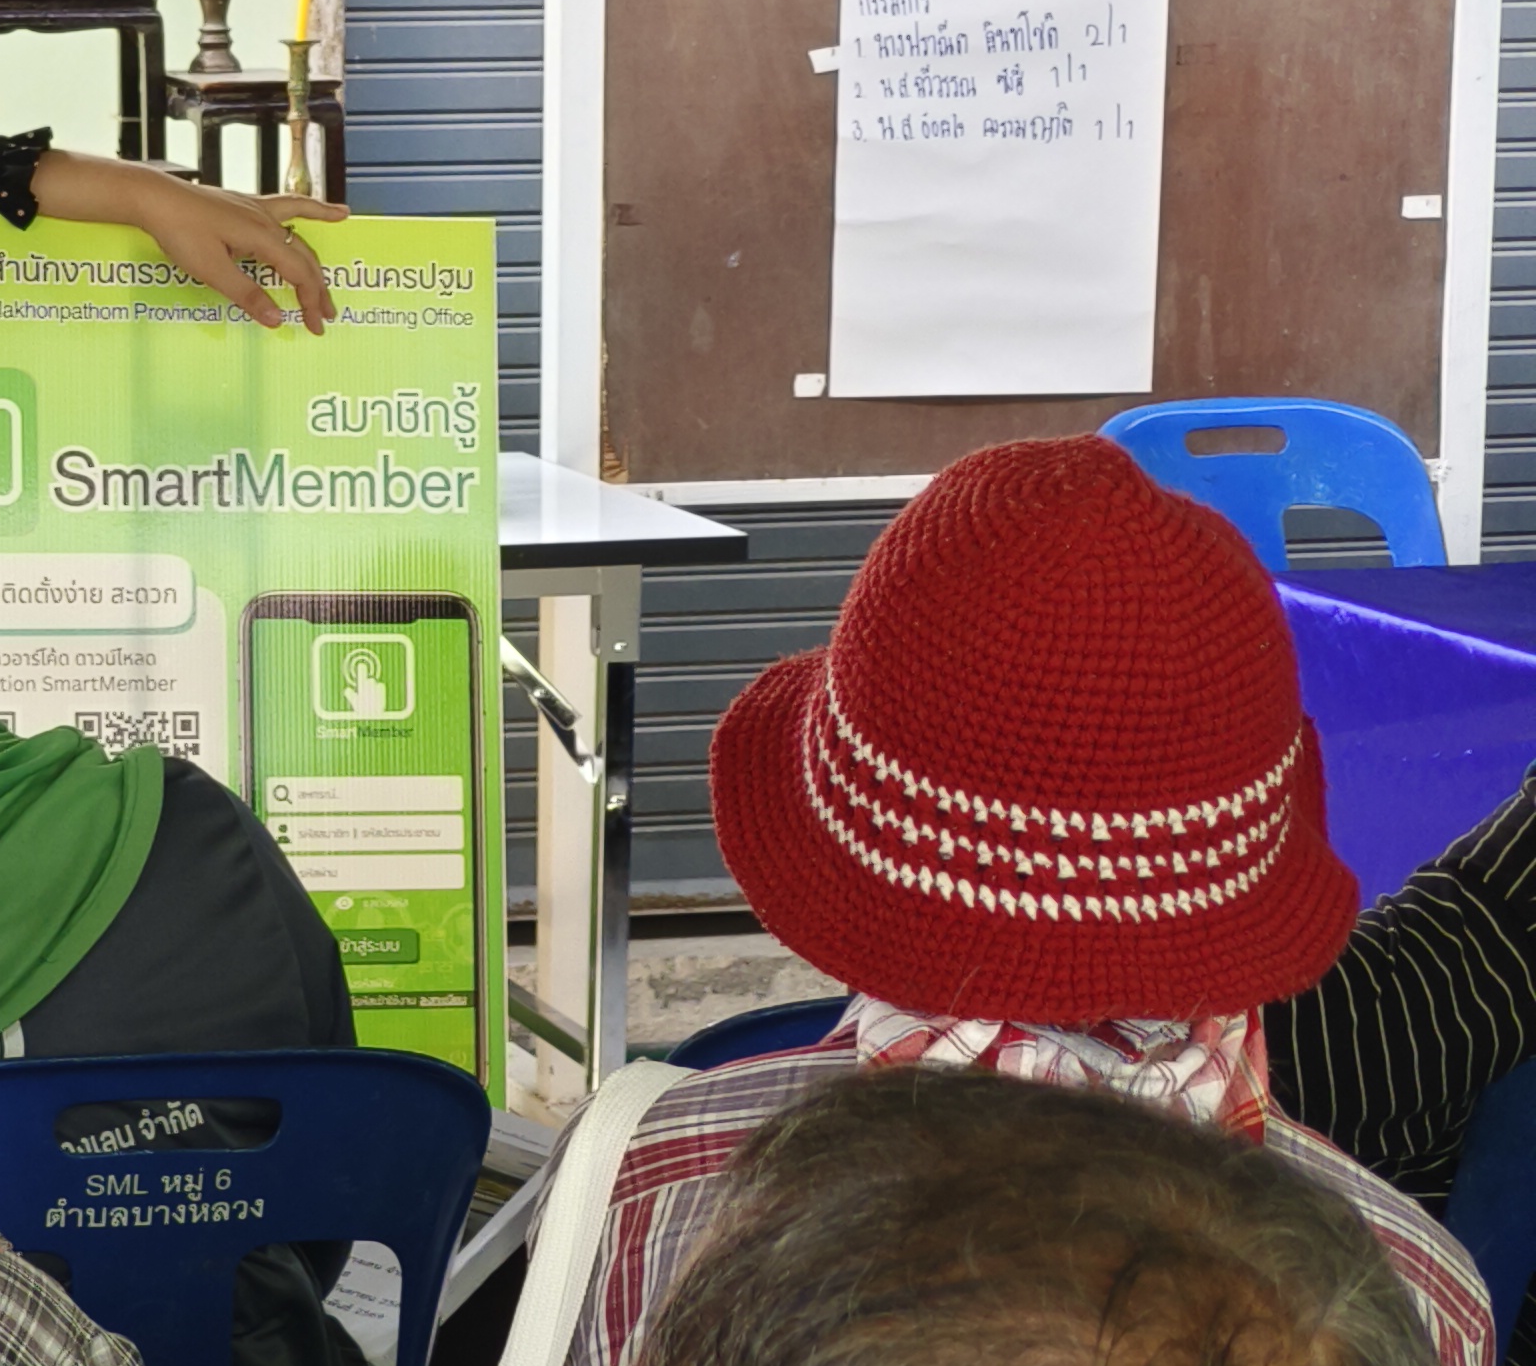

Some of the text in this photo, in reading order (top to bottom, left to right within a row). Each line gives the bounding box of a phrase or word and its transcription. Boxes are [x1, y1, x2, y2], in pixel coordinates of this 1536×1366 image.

[135, 302, 222, 323] Provincial
[341, 306, 417, 329] Auditting
[422, 306, 474, 327] Office
[311, 386, 476, 449] สมาชิกรู้
[54, 449, 475, 510] SmartMember
[111, 585, 177, 604] สะดวก
[75, 647, 156, 666] ดาวน์โหลด
[42, 675, 177, 692] SmartMember
[339, 936, 401, 957] ข้าสู่ระบบ
[138, 1100, 205, 1140] จำกัด
[85, 1167, 233, 1202] SML หมู่ 6
[44, 1197, 266, 1228] ตำบลบางหลวง
